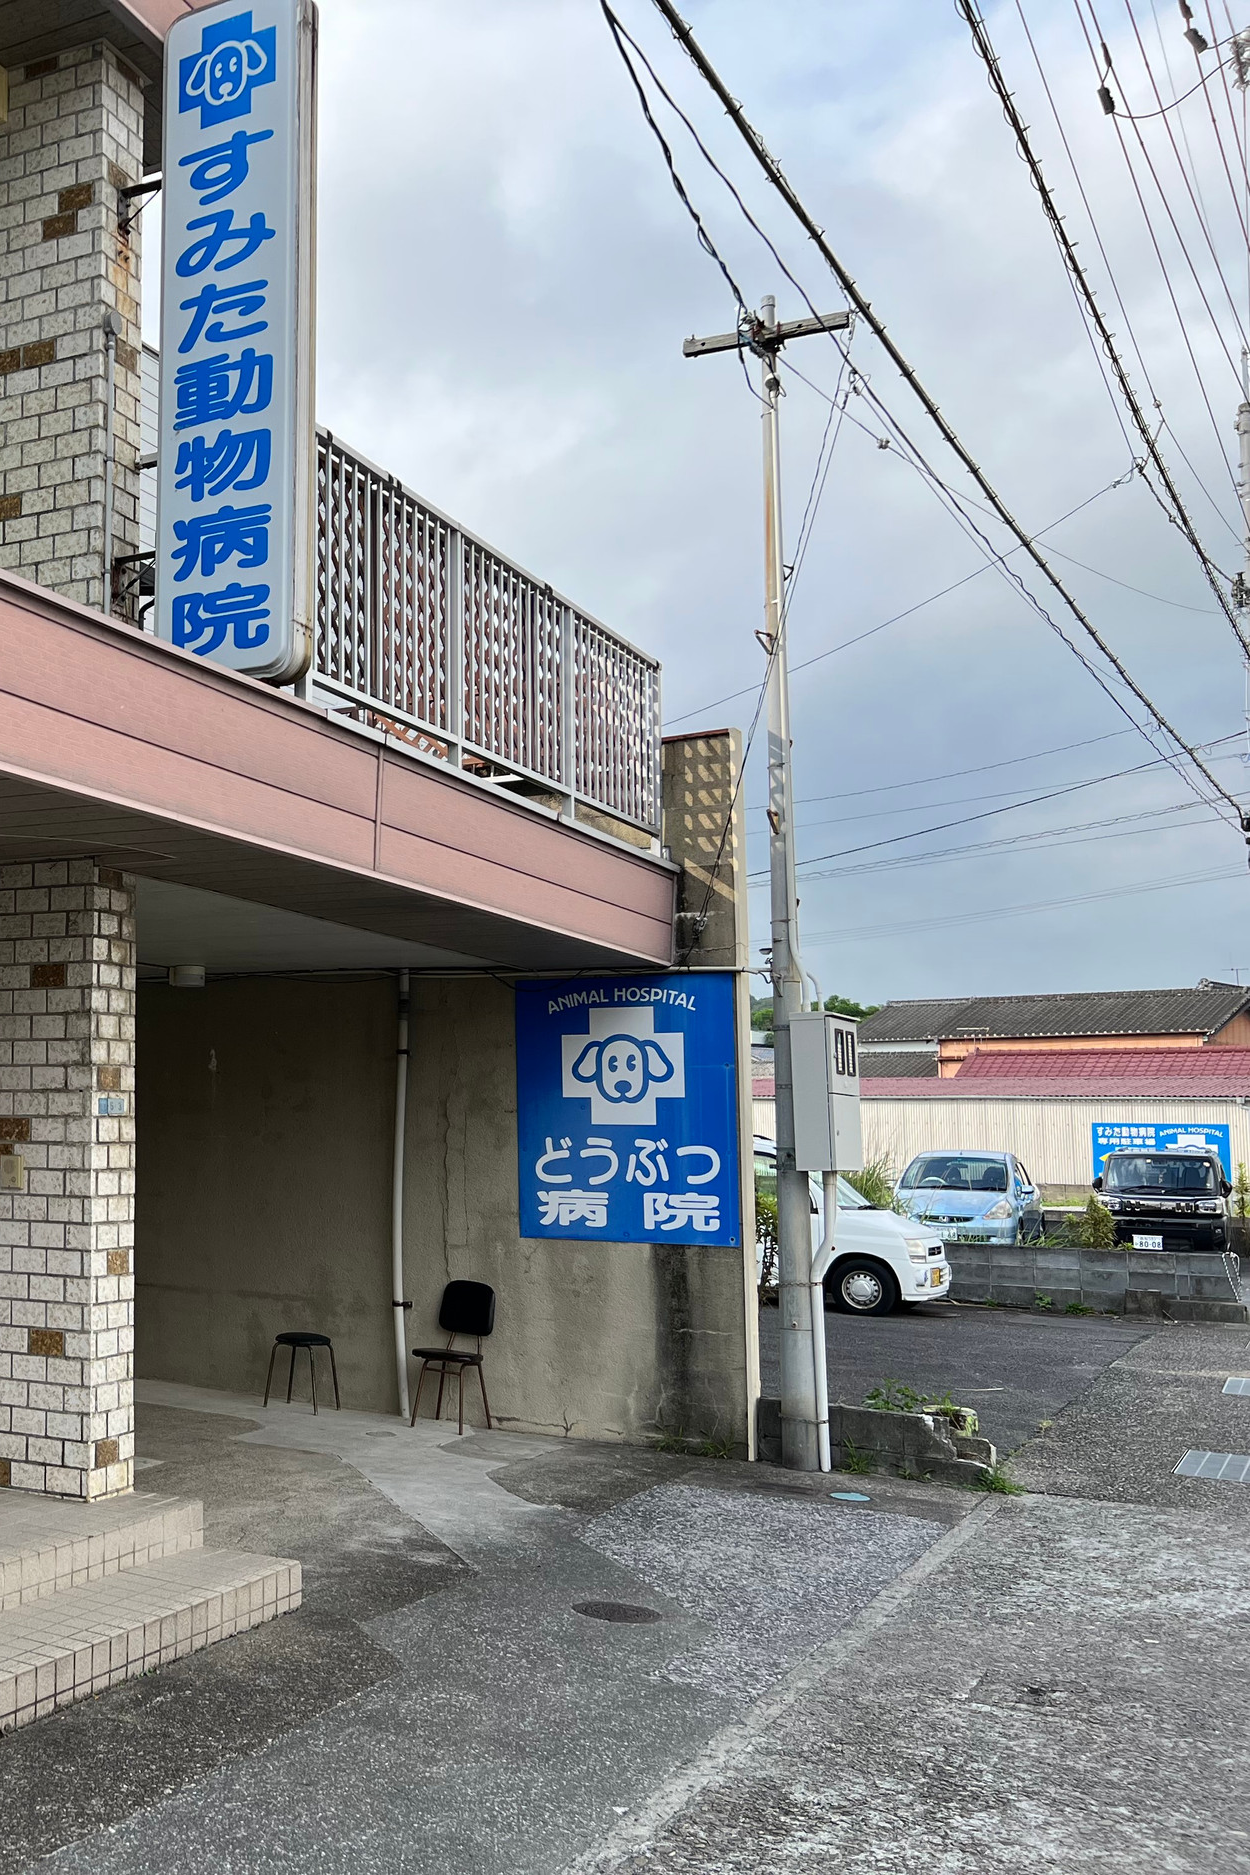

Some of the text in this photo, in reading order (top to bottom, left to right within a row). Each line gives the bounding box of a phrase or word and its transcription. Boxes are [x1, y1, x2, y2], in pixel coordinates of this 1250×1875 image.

[172, 129, 277, 656] すみた動物病院
[548, 987, 696, 1015] ANIMAL HOSPITAL
[1096, 1126, 1155, 1137] すみた動物病院
[1159, 1127, 1223, 1138] ANIMAL HOSPITAL
[535, 1137, 721, 1186] どうぶつ
[537, 1189, 720, 1231] 病院
